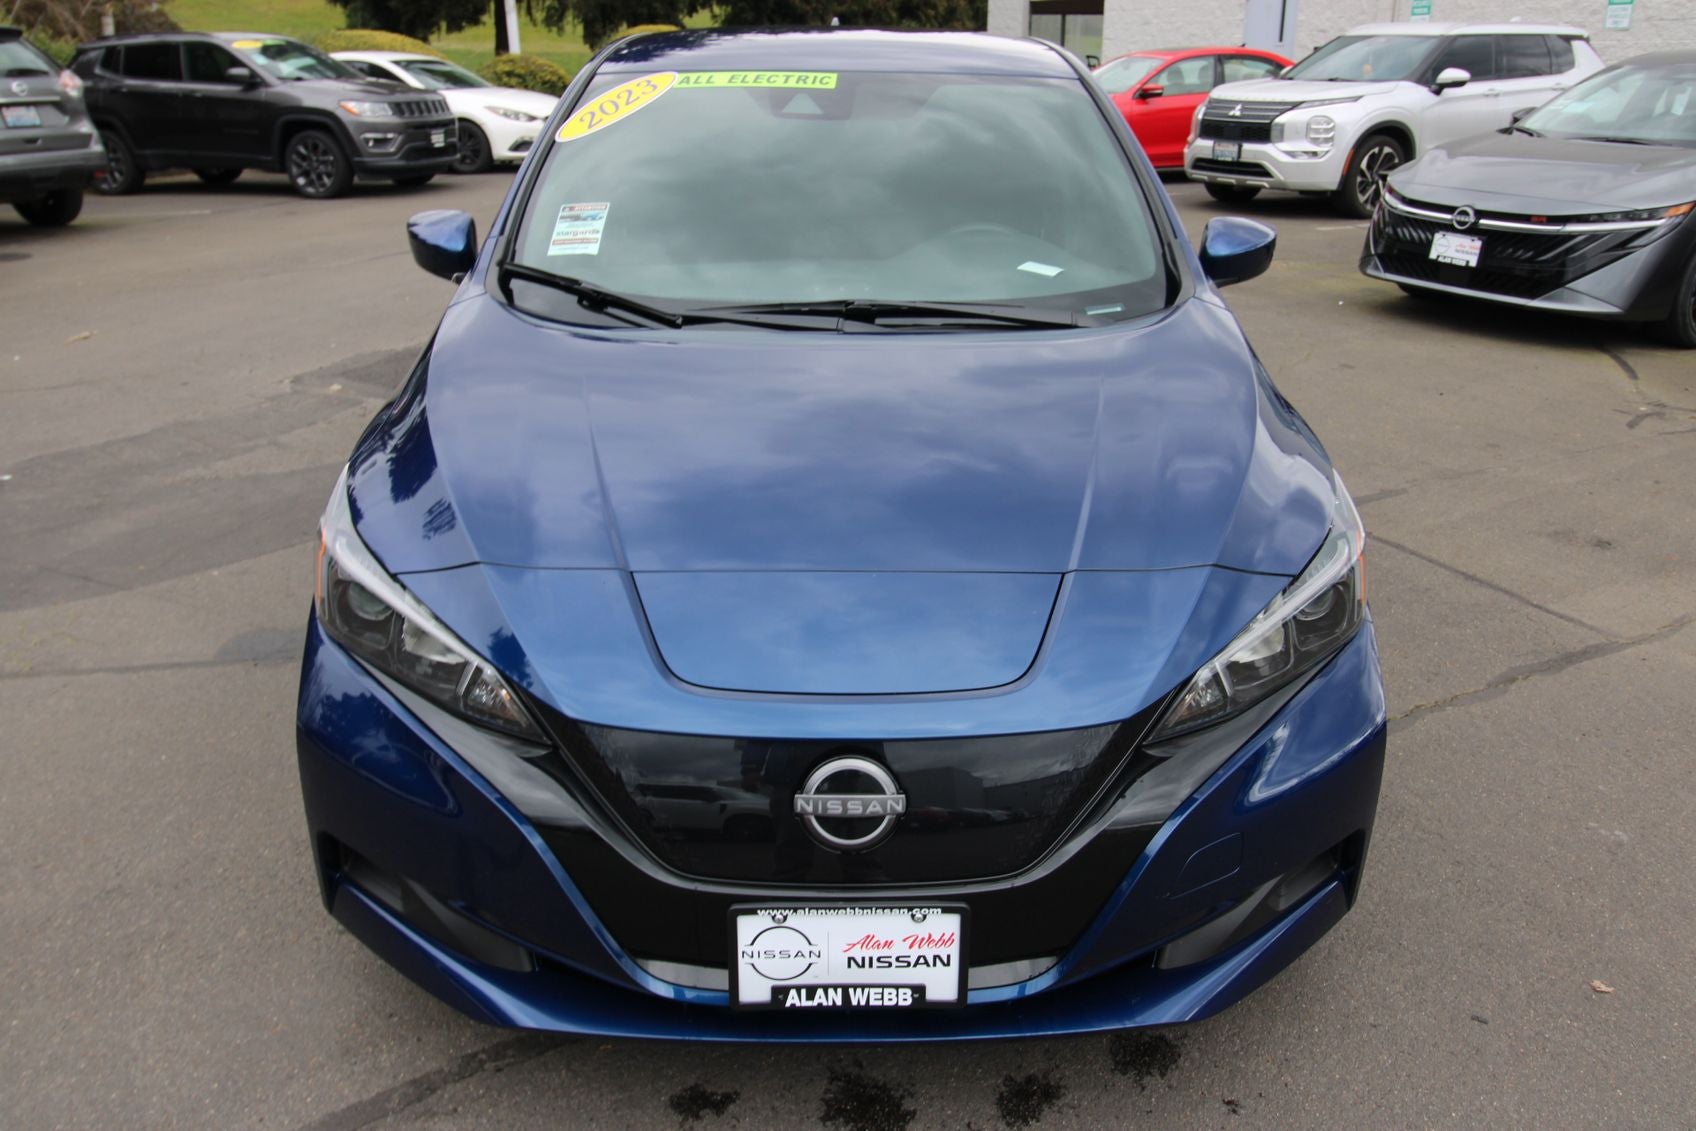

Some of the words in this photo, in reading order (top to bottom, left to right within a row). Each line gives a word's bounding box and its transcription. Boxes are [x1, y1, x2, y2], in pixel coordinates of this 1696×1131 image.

[677, 74, 716, 86] ALL
[727, 73, 833, 86] ELECTRIC
[579, 79, 659, 130] 2023
[796, 797, 903, 815] NISSAN
[757, 907, 942, 917] www.alanwebbnissan.com
[842, 933, 896, 953] Alan
[901, 931, 956, 950] Webb
[741, 949, 821, 960] NISSAN
[846, 953, 952, 969] NISSAN
[784, 987, 843, 1008] ALAN
[848, 987, 913, 1007] WEBB
